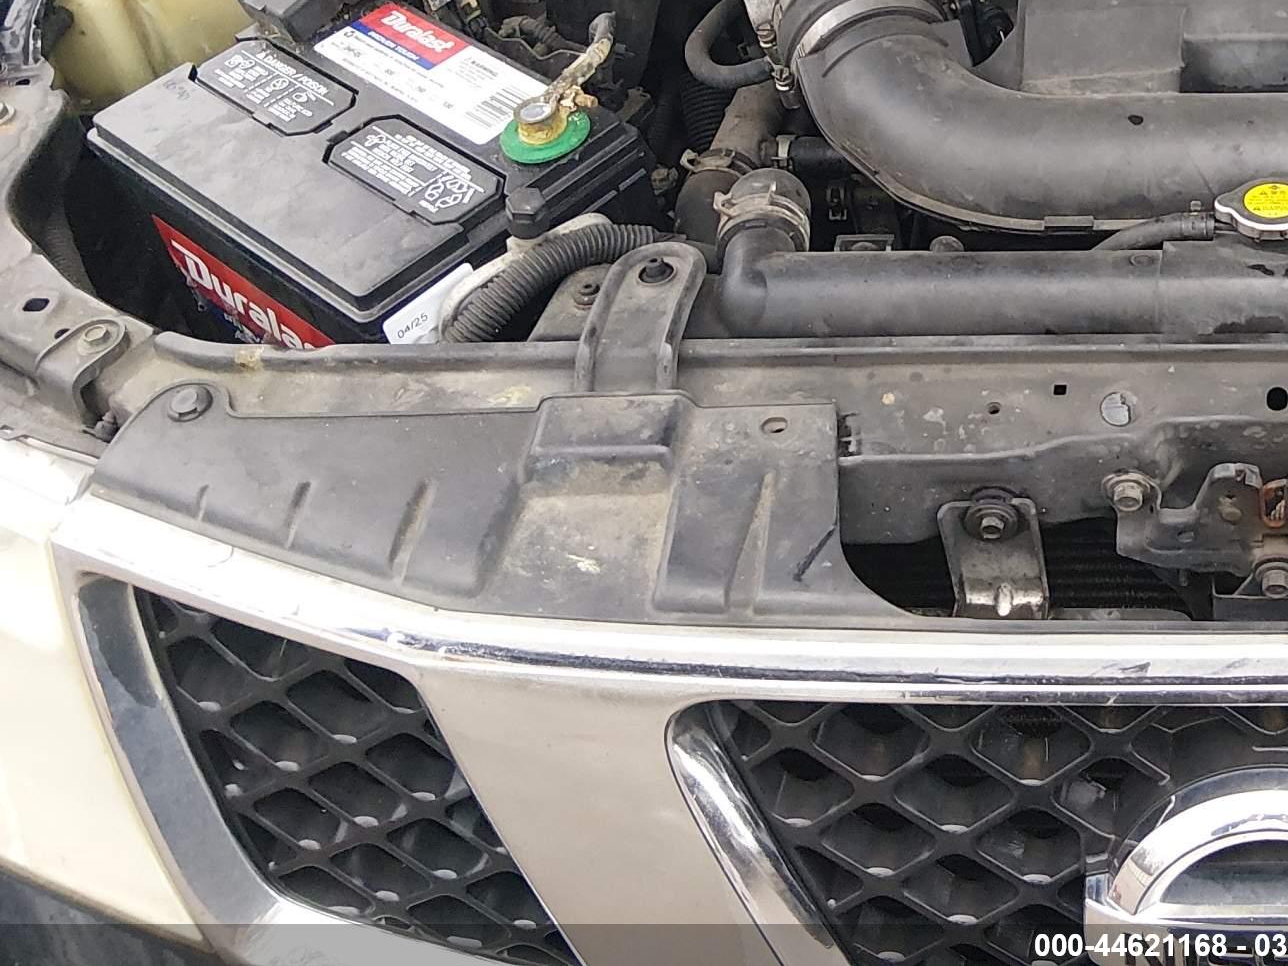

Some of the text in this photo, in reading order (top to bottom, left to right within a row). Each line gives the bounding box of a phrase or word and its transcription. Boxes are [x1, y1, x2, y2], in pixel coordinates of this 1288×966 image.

[381, 10, 455, 53] Duralast
[264, 55, 297, 75] DANGER
[298, 76, 329, 95] POISON
[171, 239, 316, 349] Durala
[397, 313, 428, 339] 04/25
